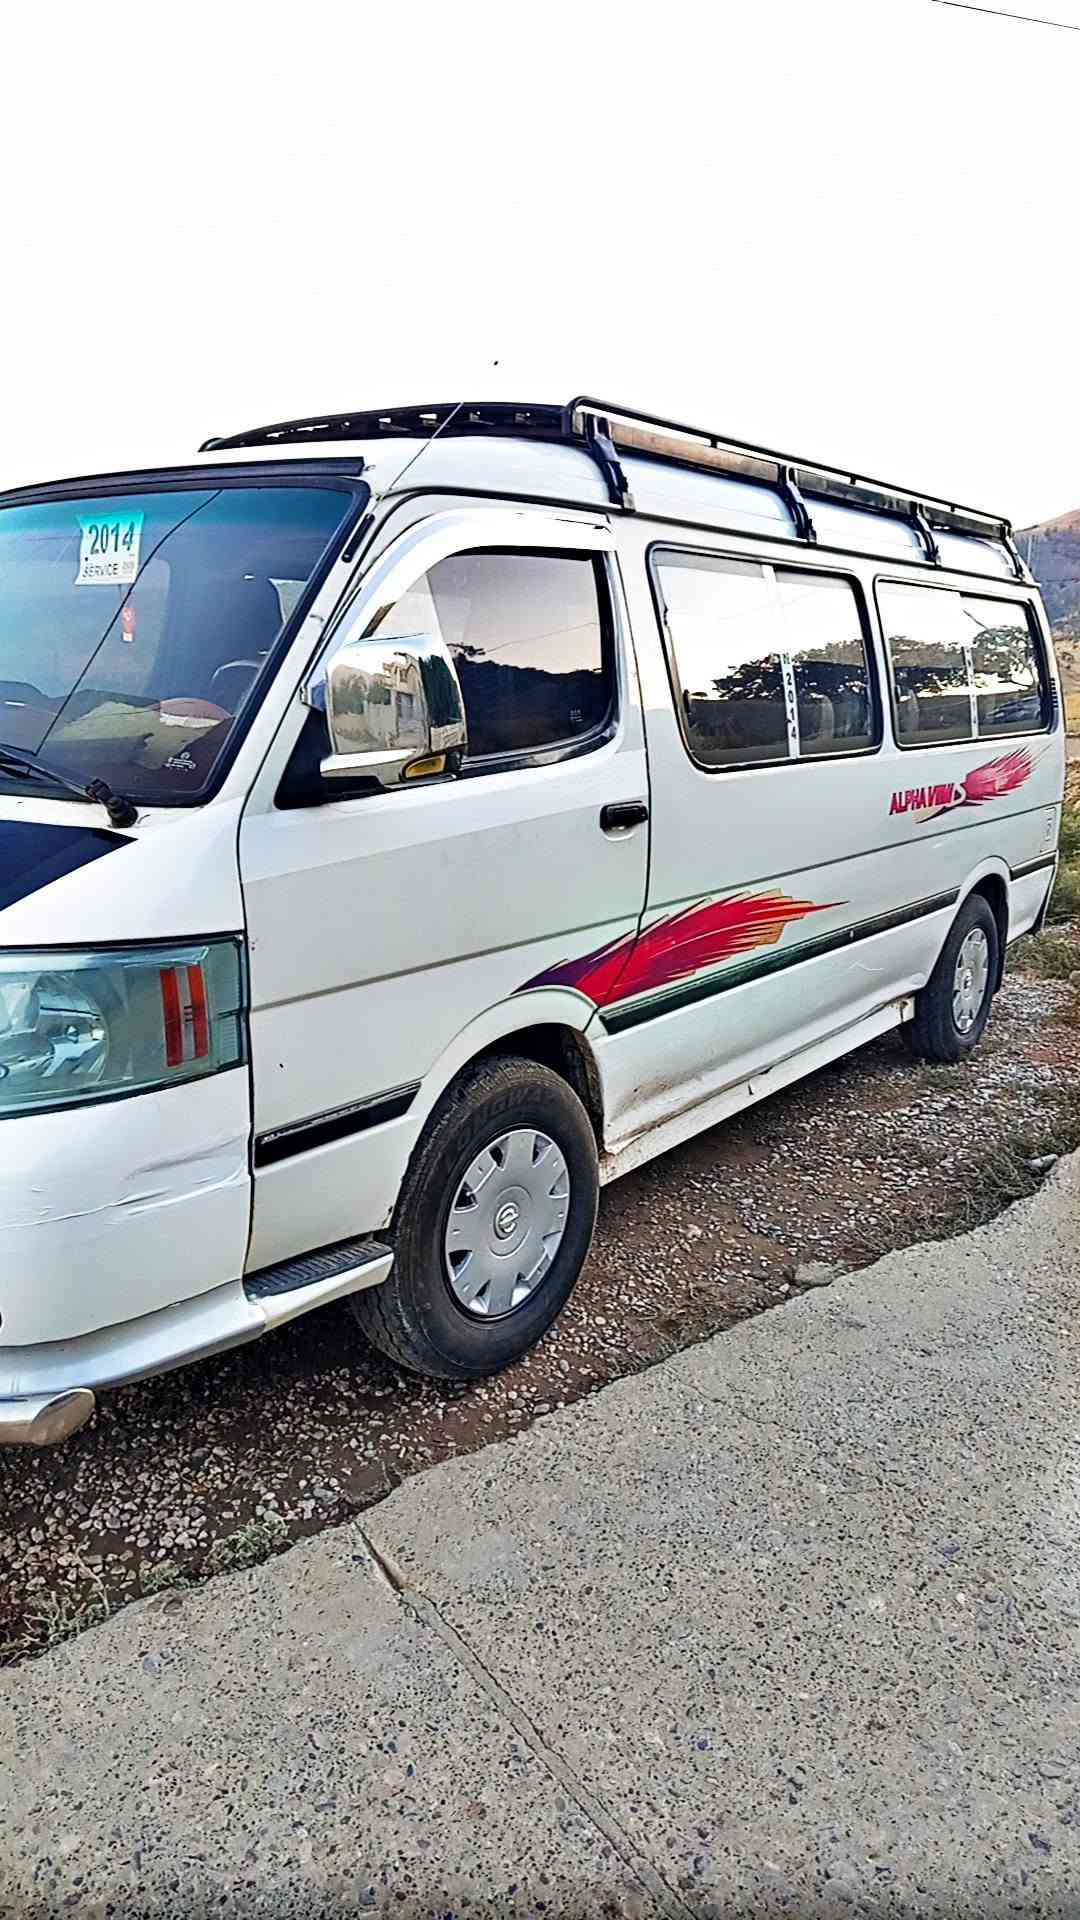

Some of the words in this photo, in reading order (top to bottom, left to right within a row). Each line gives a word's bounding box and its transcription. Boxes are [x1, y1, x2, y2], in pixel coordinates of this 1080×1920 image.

[88, 521, 135, 555] 2014
[82, 563, 119, 578] SERVICE
[785, 672, 797, 739] 2014
[889, 786, 927, 815] ALPHA
